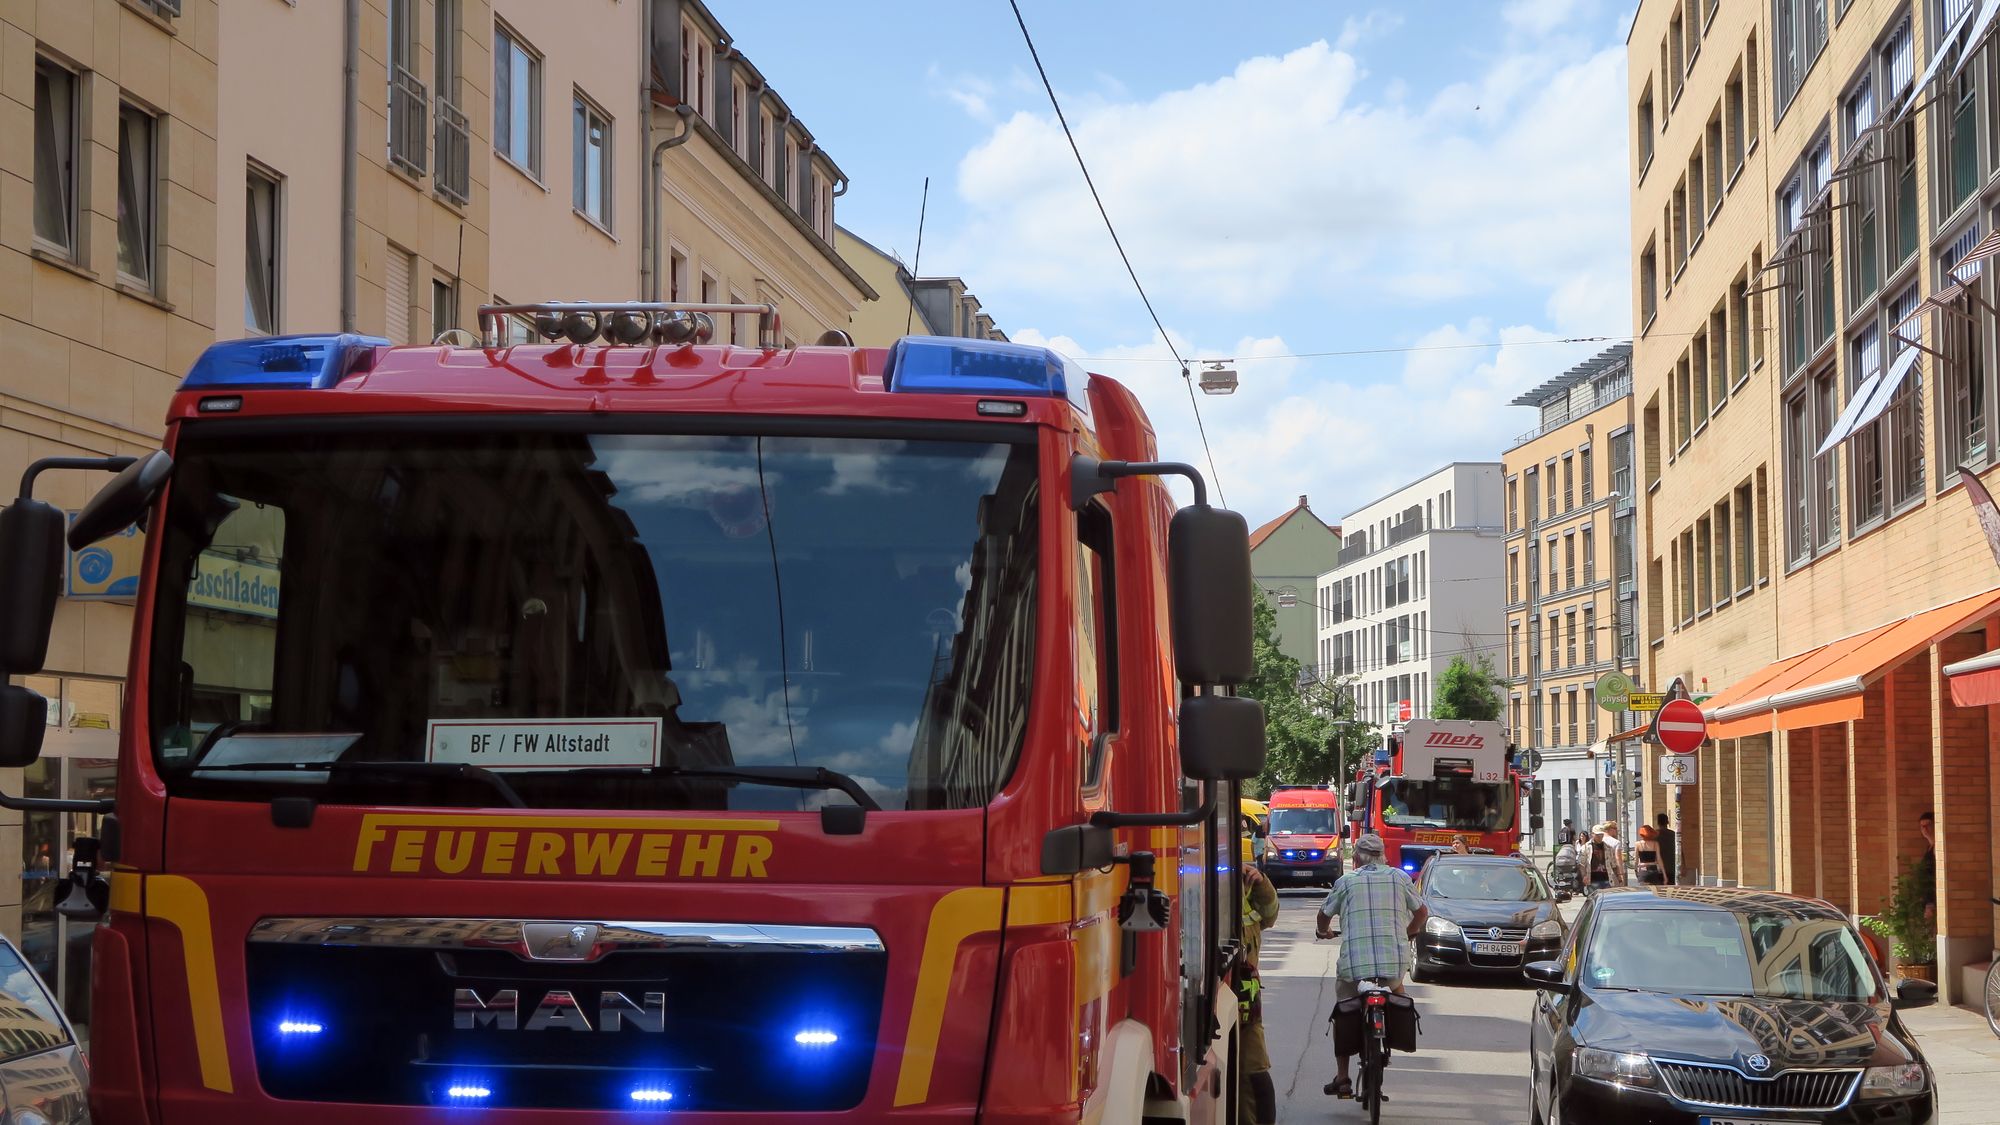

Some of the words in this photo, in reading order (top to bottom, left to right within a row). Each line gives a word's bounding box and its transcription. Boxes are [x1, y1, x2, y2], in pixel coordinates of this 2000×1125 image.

[188, 568, 279, 609] aschladen
[1601, 694, 1628, 705] physio
[470, 734, 491, 753] BF
[498, 734, 506, 753] /
[513, 734, 539, 753] FW
[545, 733, 610, 752] Altstadt
[1424, 731, 1485, 749] Metz
[352, 814, 779, 878] FEUERWEHR
[1414, 831, 1482, 845] FEUERHR
[1476, 943, 1489, 952] PH
[453, 988, 665, 1032] MAN
